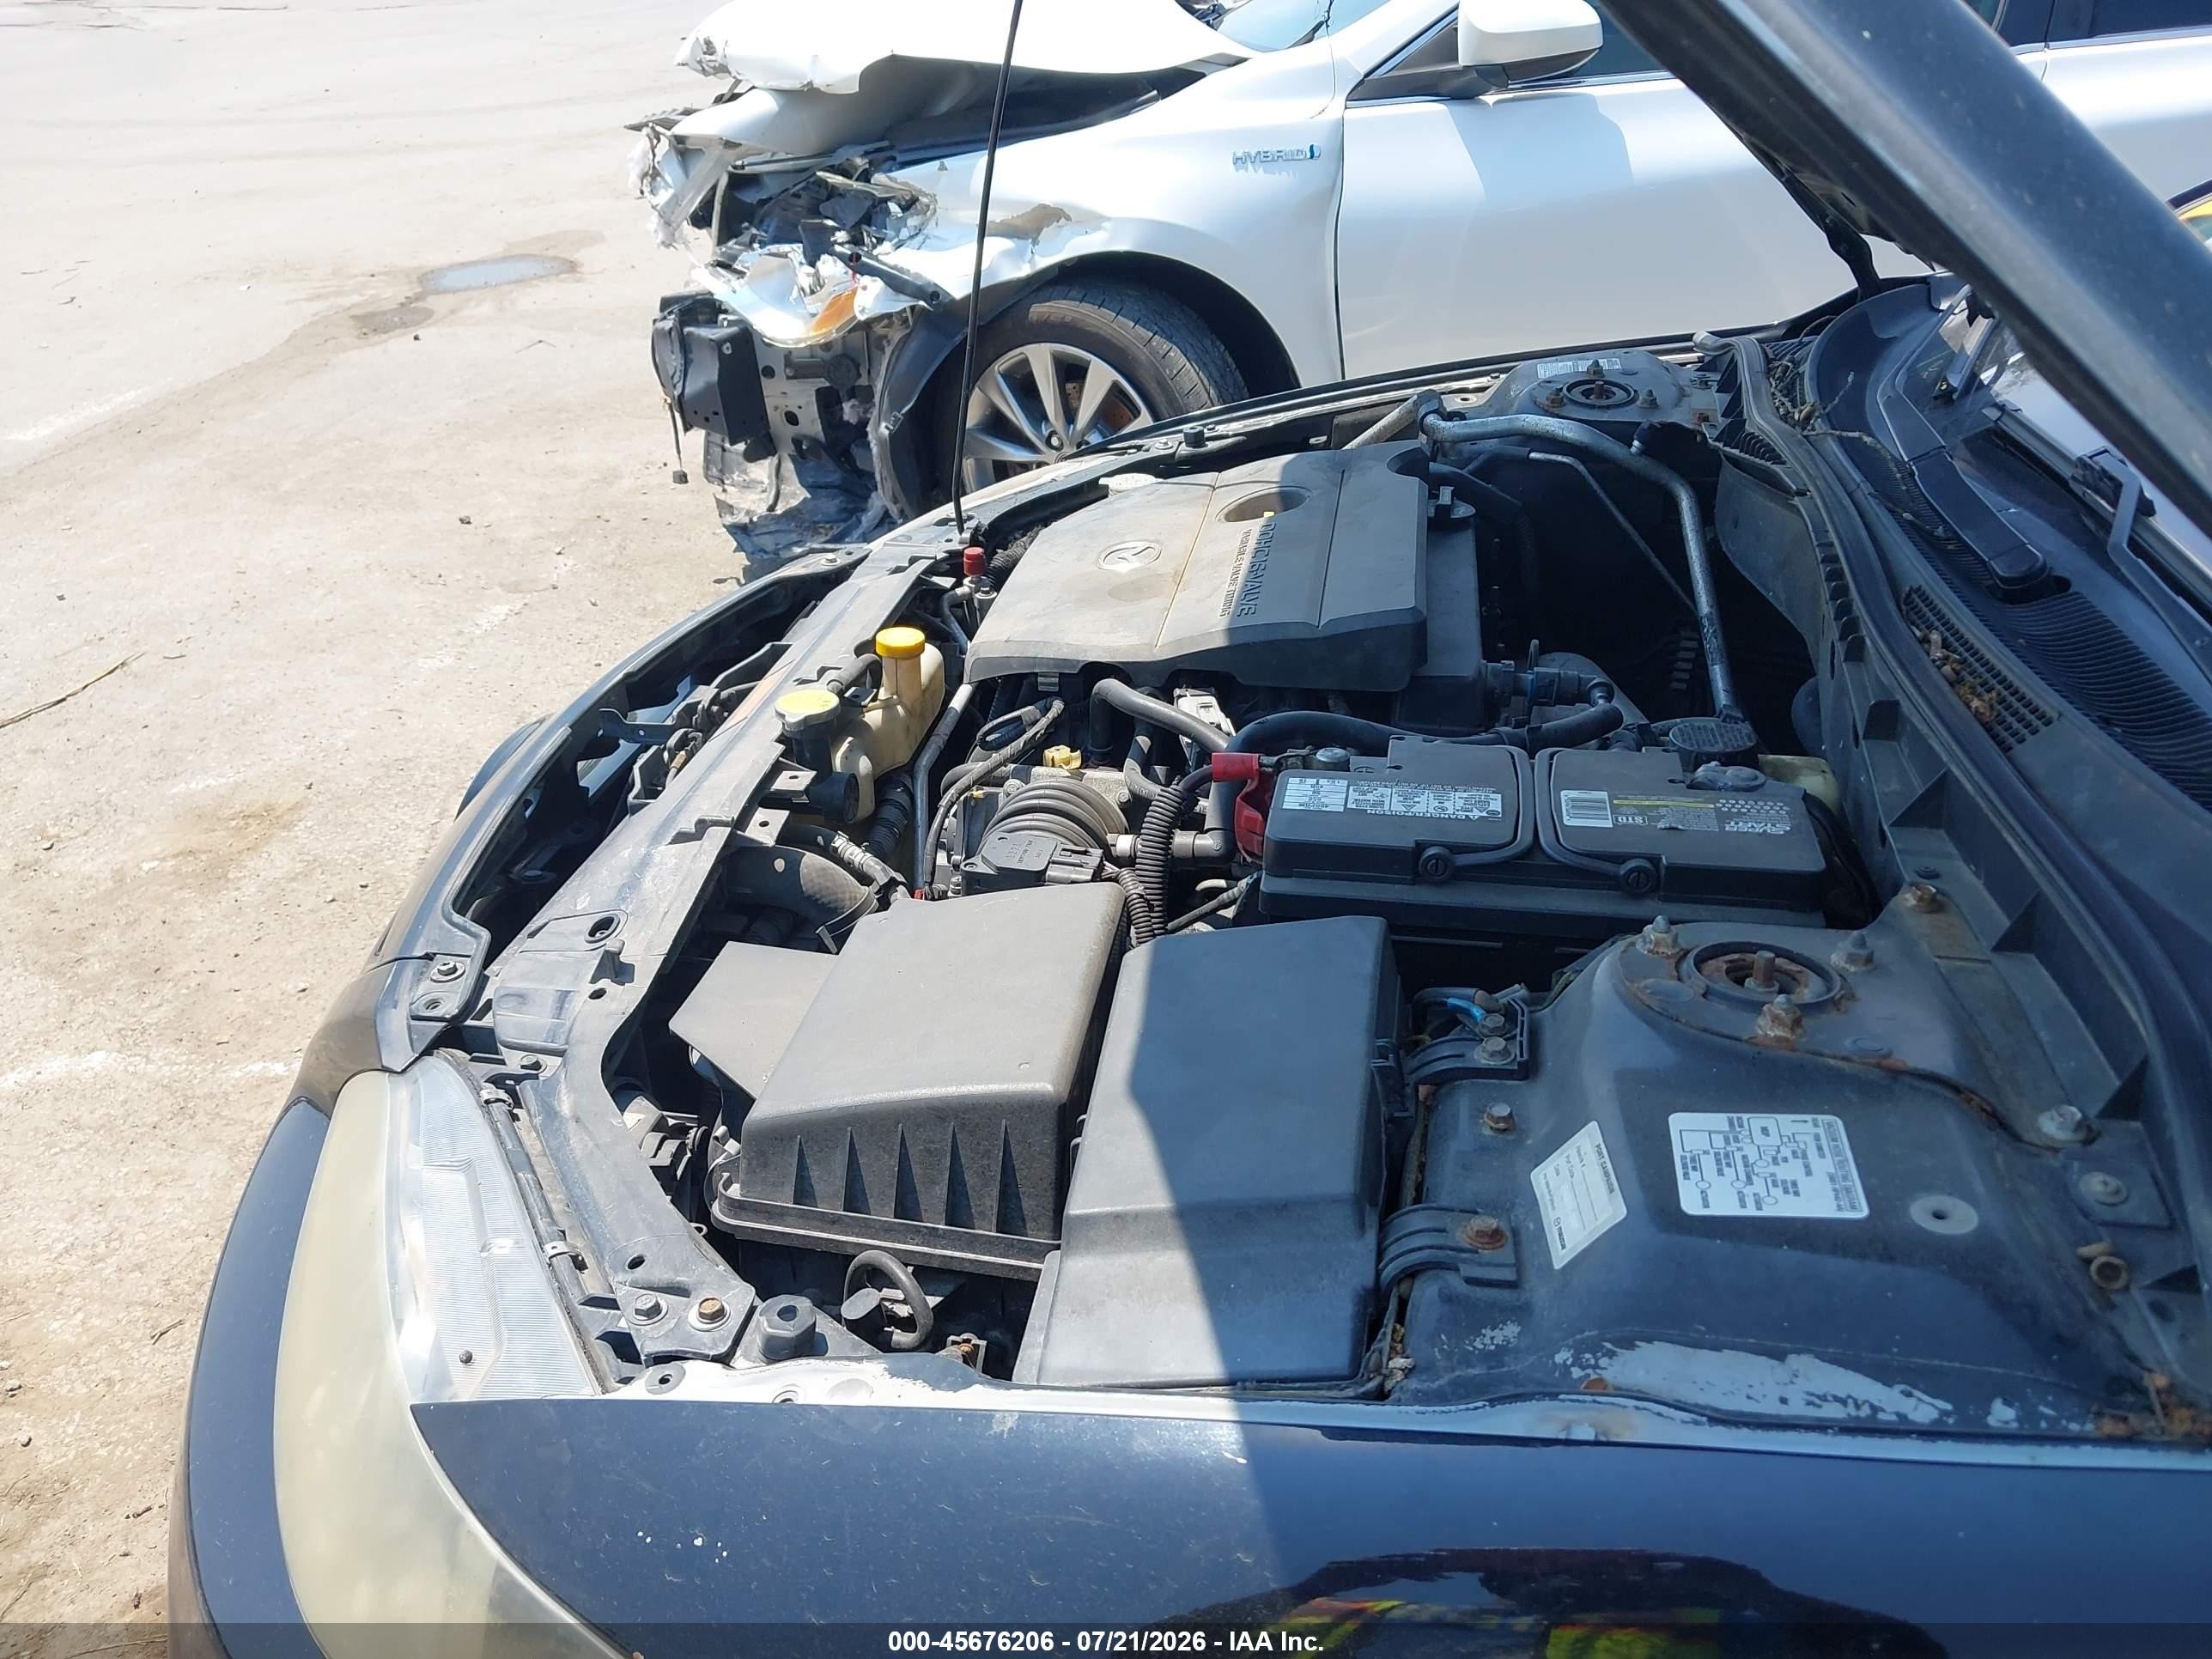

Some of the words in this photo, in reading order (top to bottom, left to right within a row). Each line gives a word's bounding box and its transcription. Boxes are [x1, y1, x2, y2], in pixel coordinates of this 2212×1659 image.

[1232, 149, 1307, 165] HYBRID
[1235, 528, 1252, 563] VARIABLE
[1252, 522, 1277, 559] DOHC
[1228, 562, 1243, 588] VALVE
